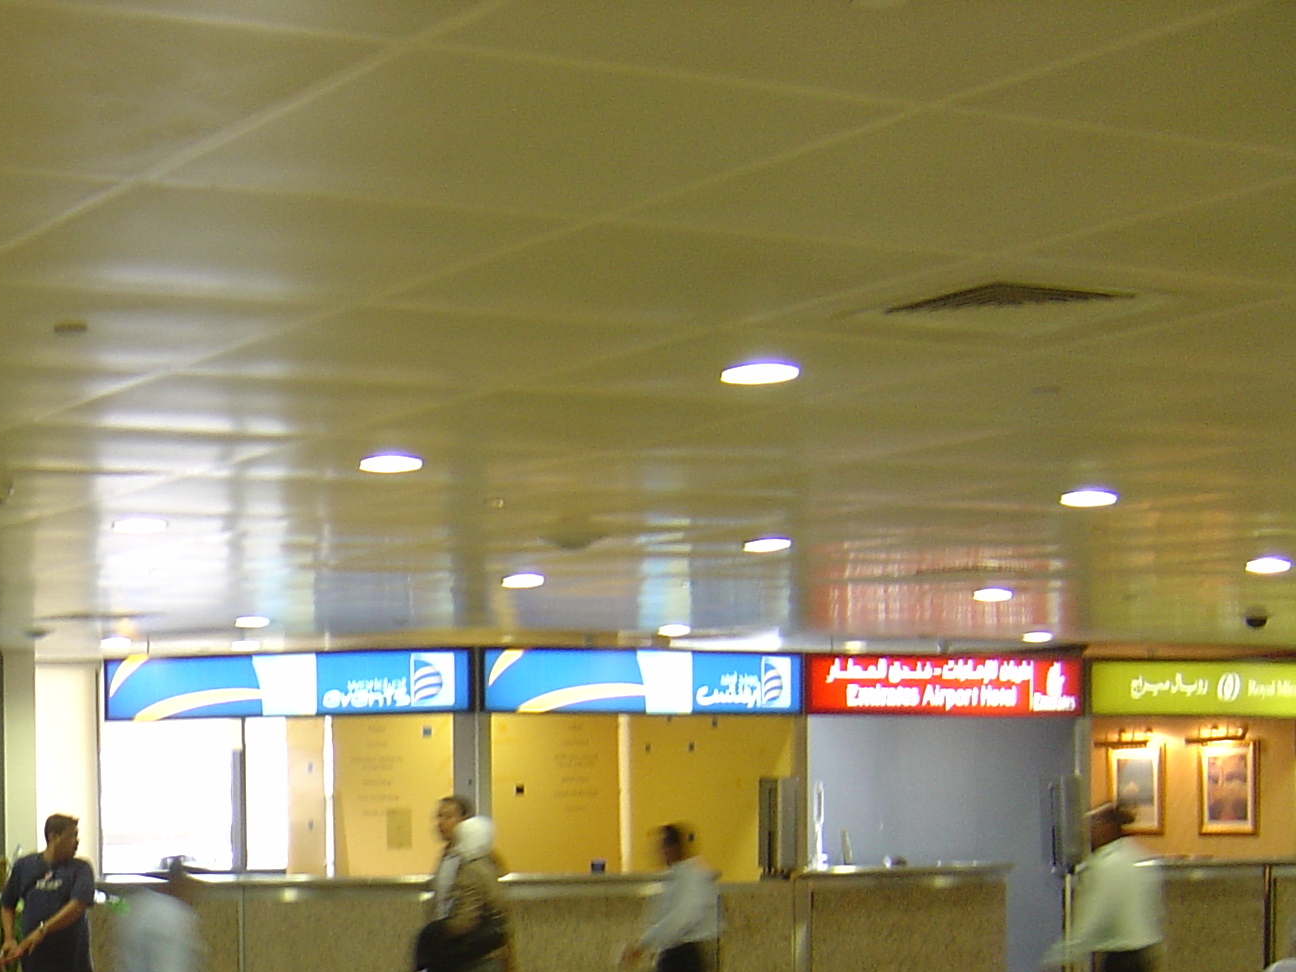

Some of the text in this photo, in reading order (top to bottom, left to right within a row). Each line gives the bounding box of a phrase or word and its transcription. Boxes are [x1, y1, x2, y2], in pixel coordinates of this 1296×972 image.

[322, 684, 412, 709] events
[846, 684, 1017, 712] Emirates Airport Hotel
[1248, 679, 1275, 701] Royal
